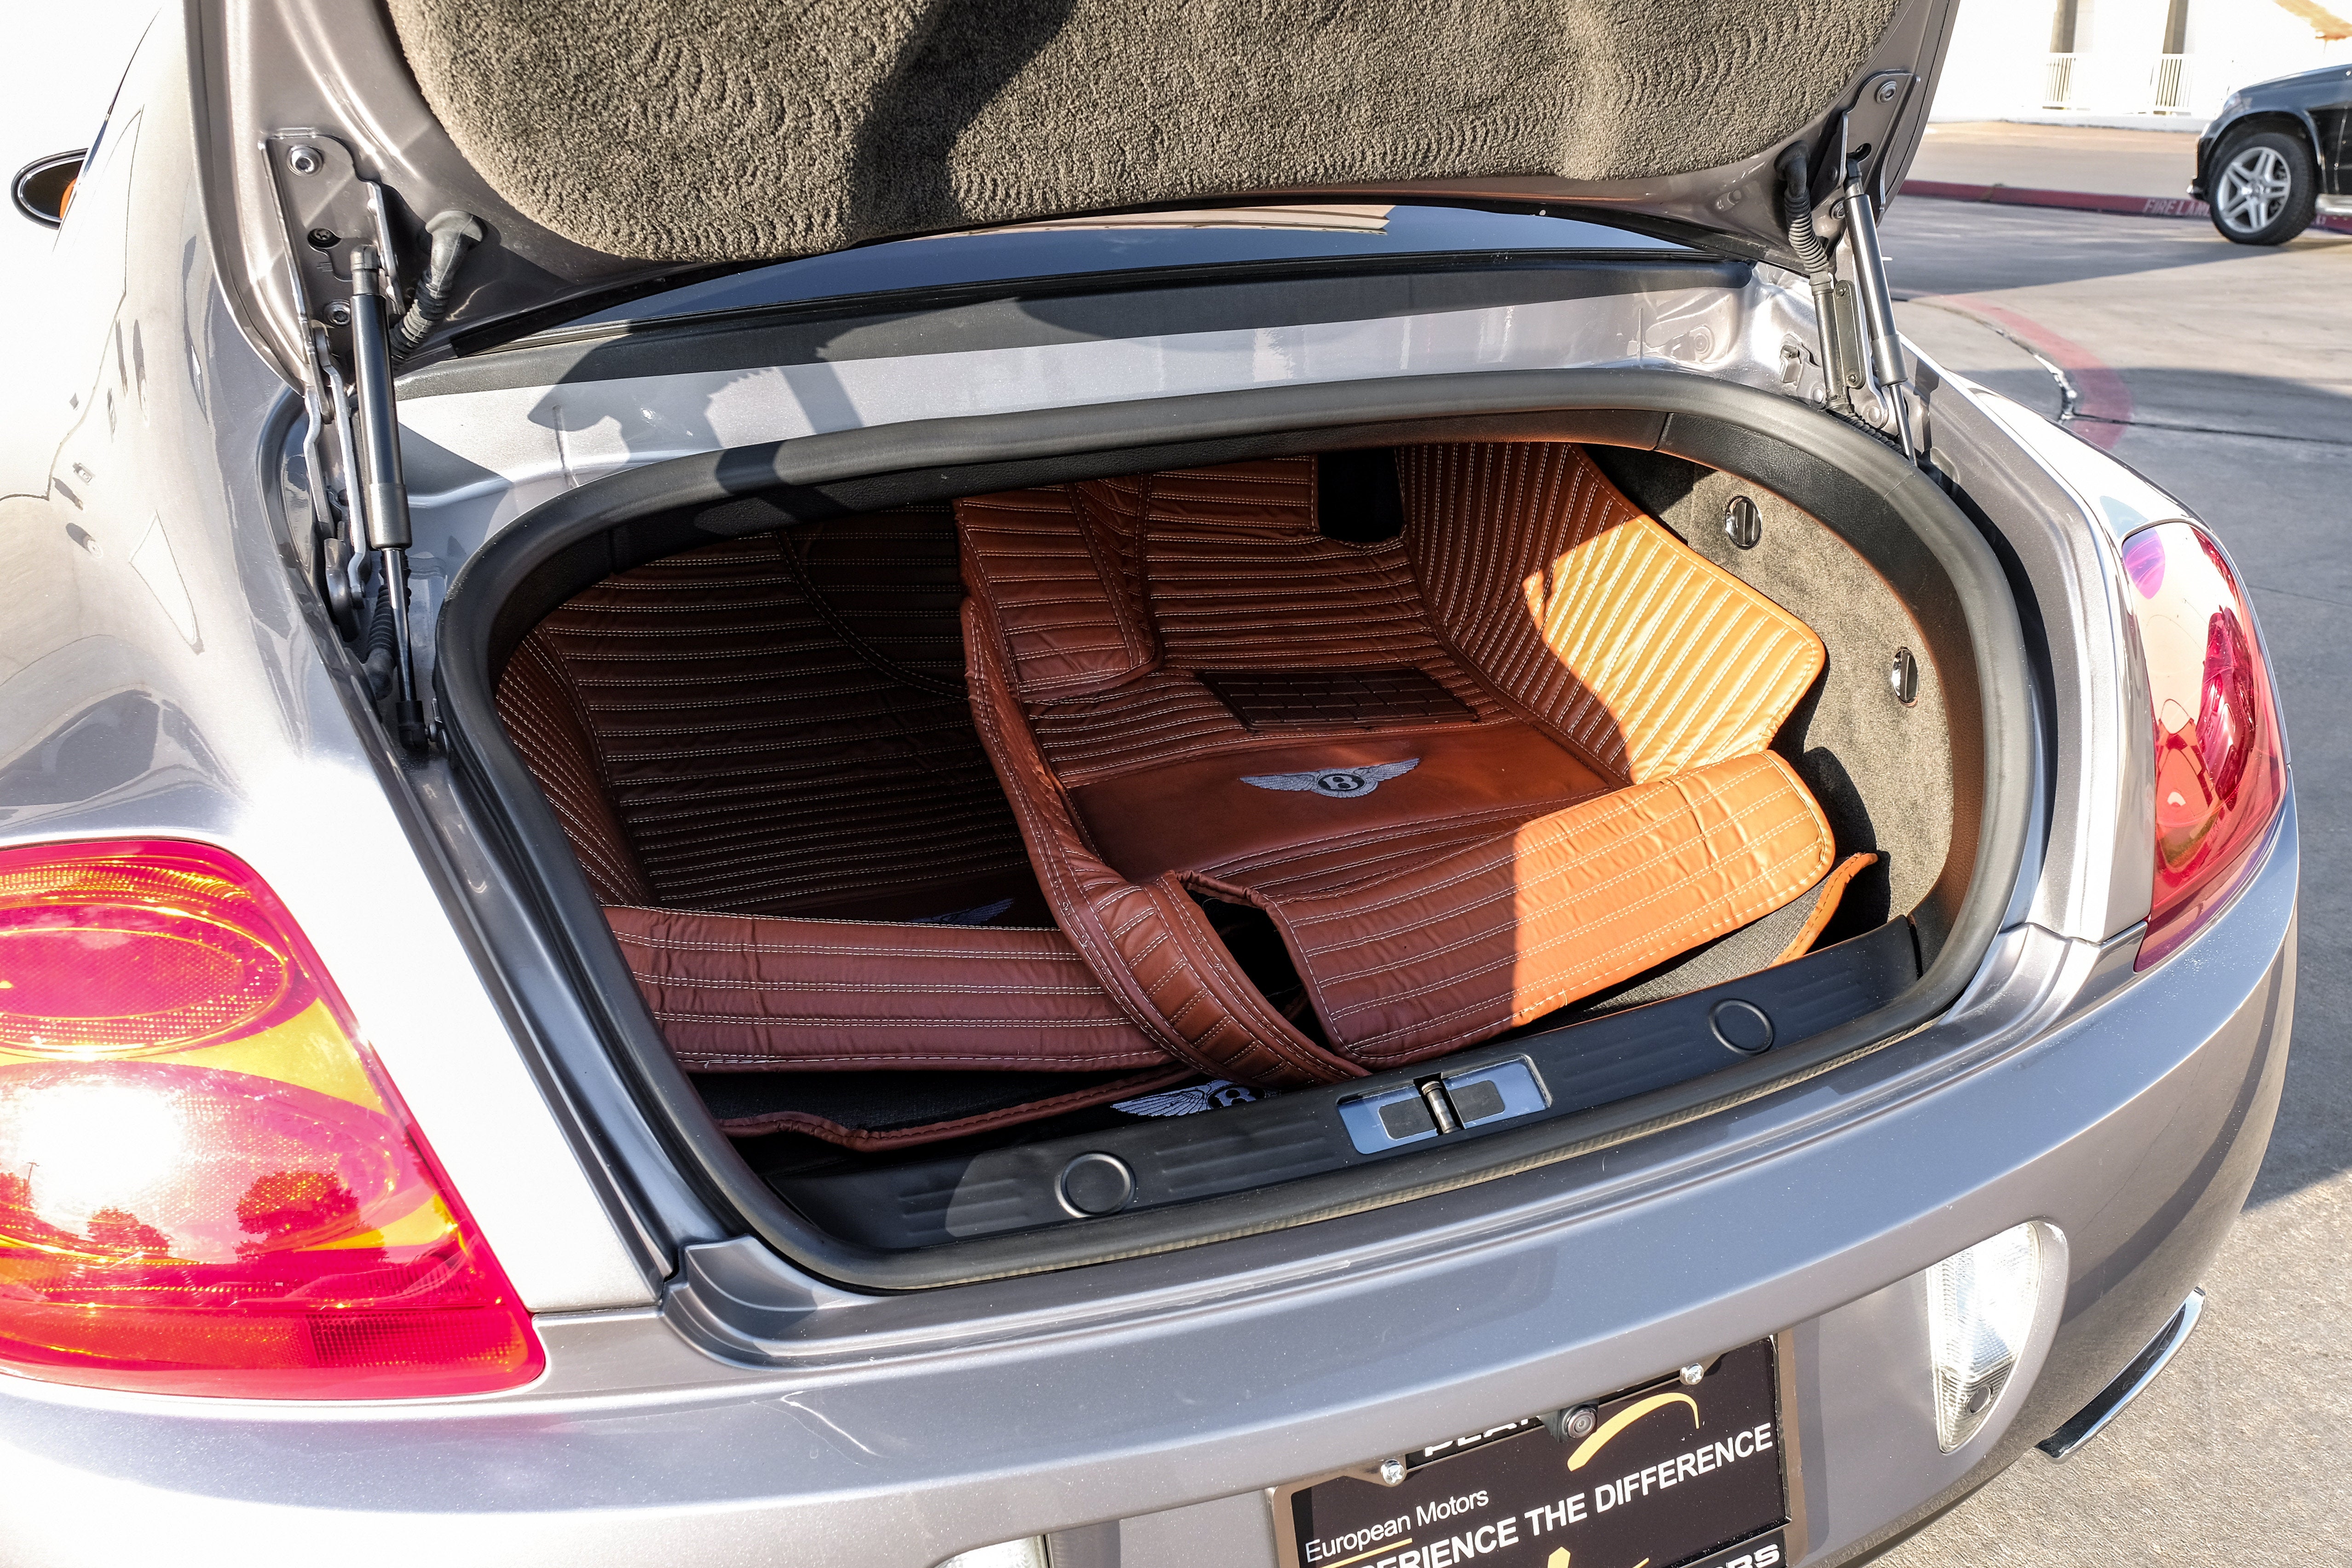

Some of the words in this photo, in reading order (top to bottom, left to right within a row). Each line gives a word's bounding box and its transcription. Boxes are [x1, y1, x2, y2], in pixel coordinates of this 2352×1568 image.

[2142, 198, 2176, 214] FIRE
[2176, 200, 2210, 216] LAN
[1323, 775, 1359, 790] B
[1524, 1493, 1587, 1536] THE
[1595, 1422, 1773, 1513] DIFFERENCE
[1306, 1515, 1411, 1563] European
[1416, 1490, 1489, 1528] Motors
